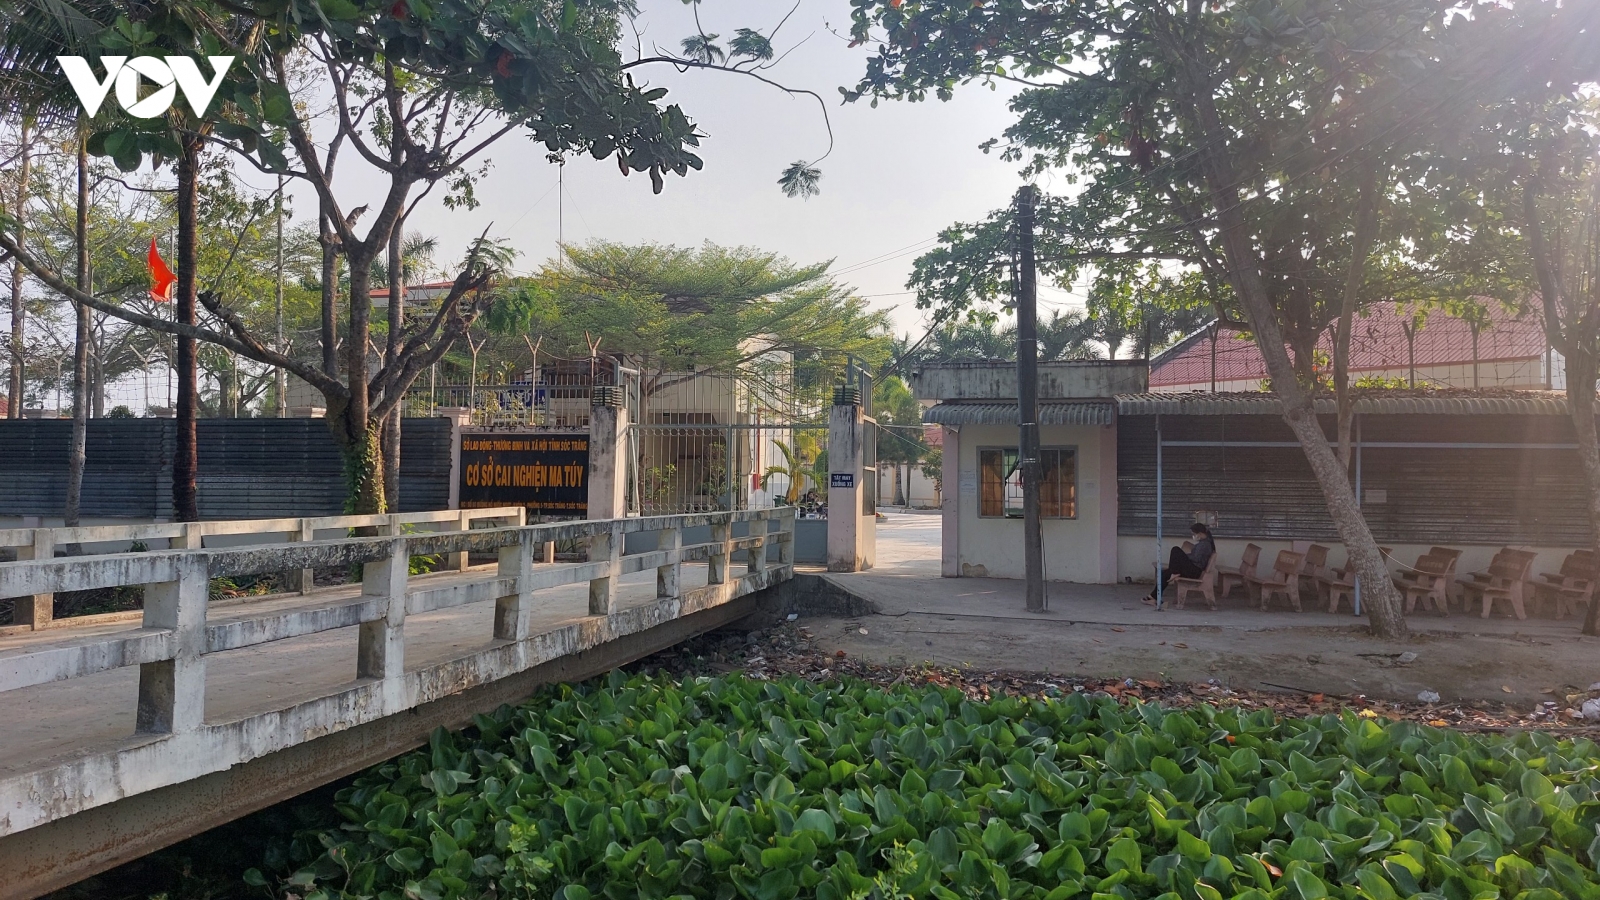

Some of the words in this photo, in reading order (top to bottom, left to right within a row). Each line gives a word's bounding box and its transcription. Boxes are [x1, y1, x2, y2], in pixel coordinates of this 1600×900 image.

[470, 440, 479, 450] LAO
[560, 439, 570, 451] SÓC
[572, 439, 587, 450] TRĂNG
[466, 461, 480, 486] CƠ
[482, 456, 494, 486] SỞ
[495, 464, 511, 486] CAI
[513, 460, 547, 492] NGHIỆN
[549, 465, 562, 487] MA
[564, 460, 584, 488] TÚY
